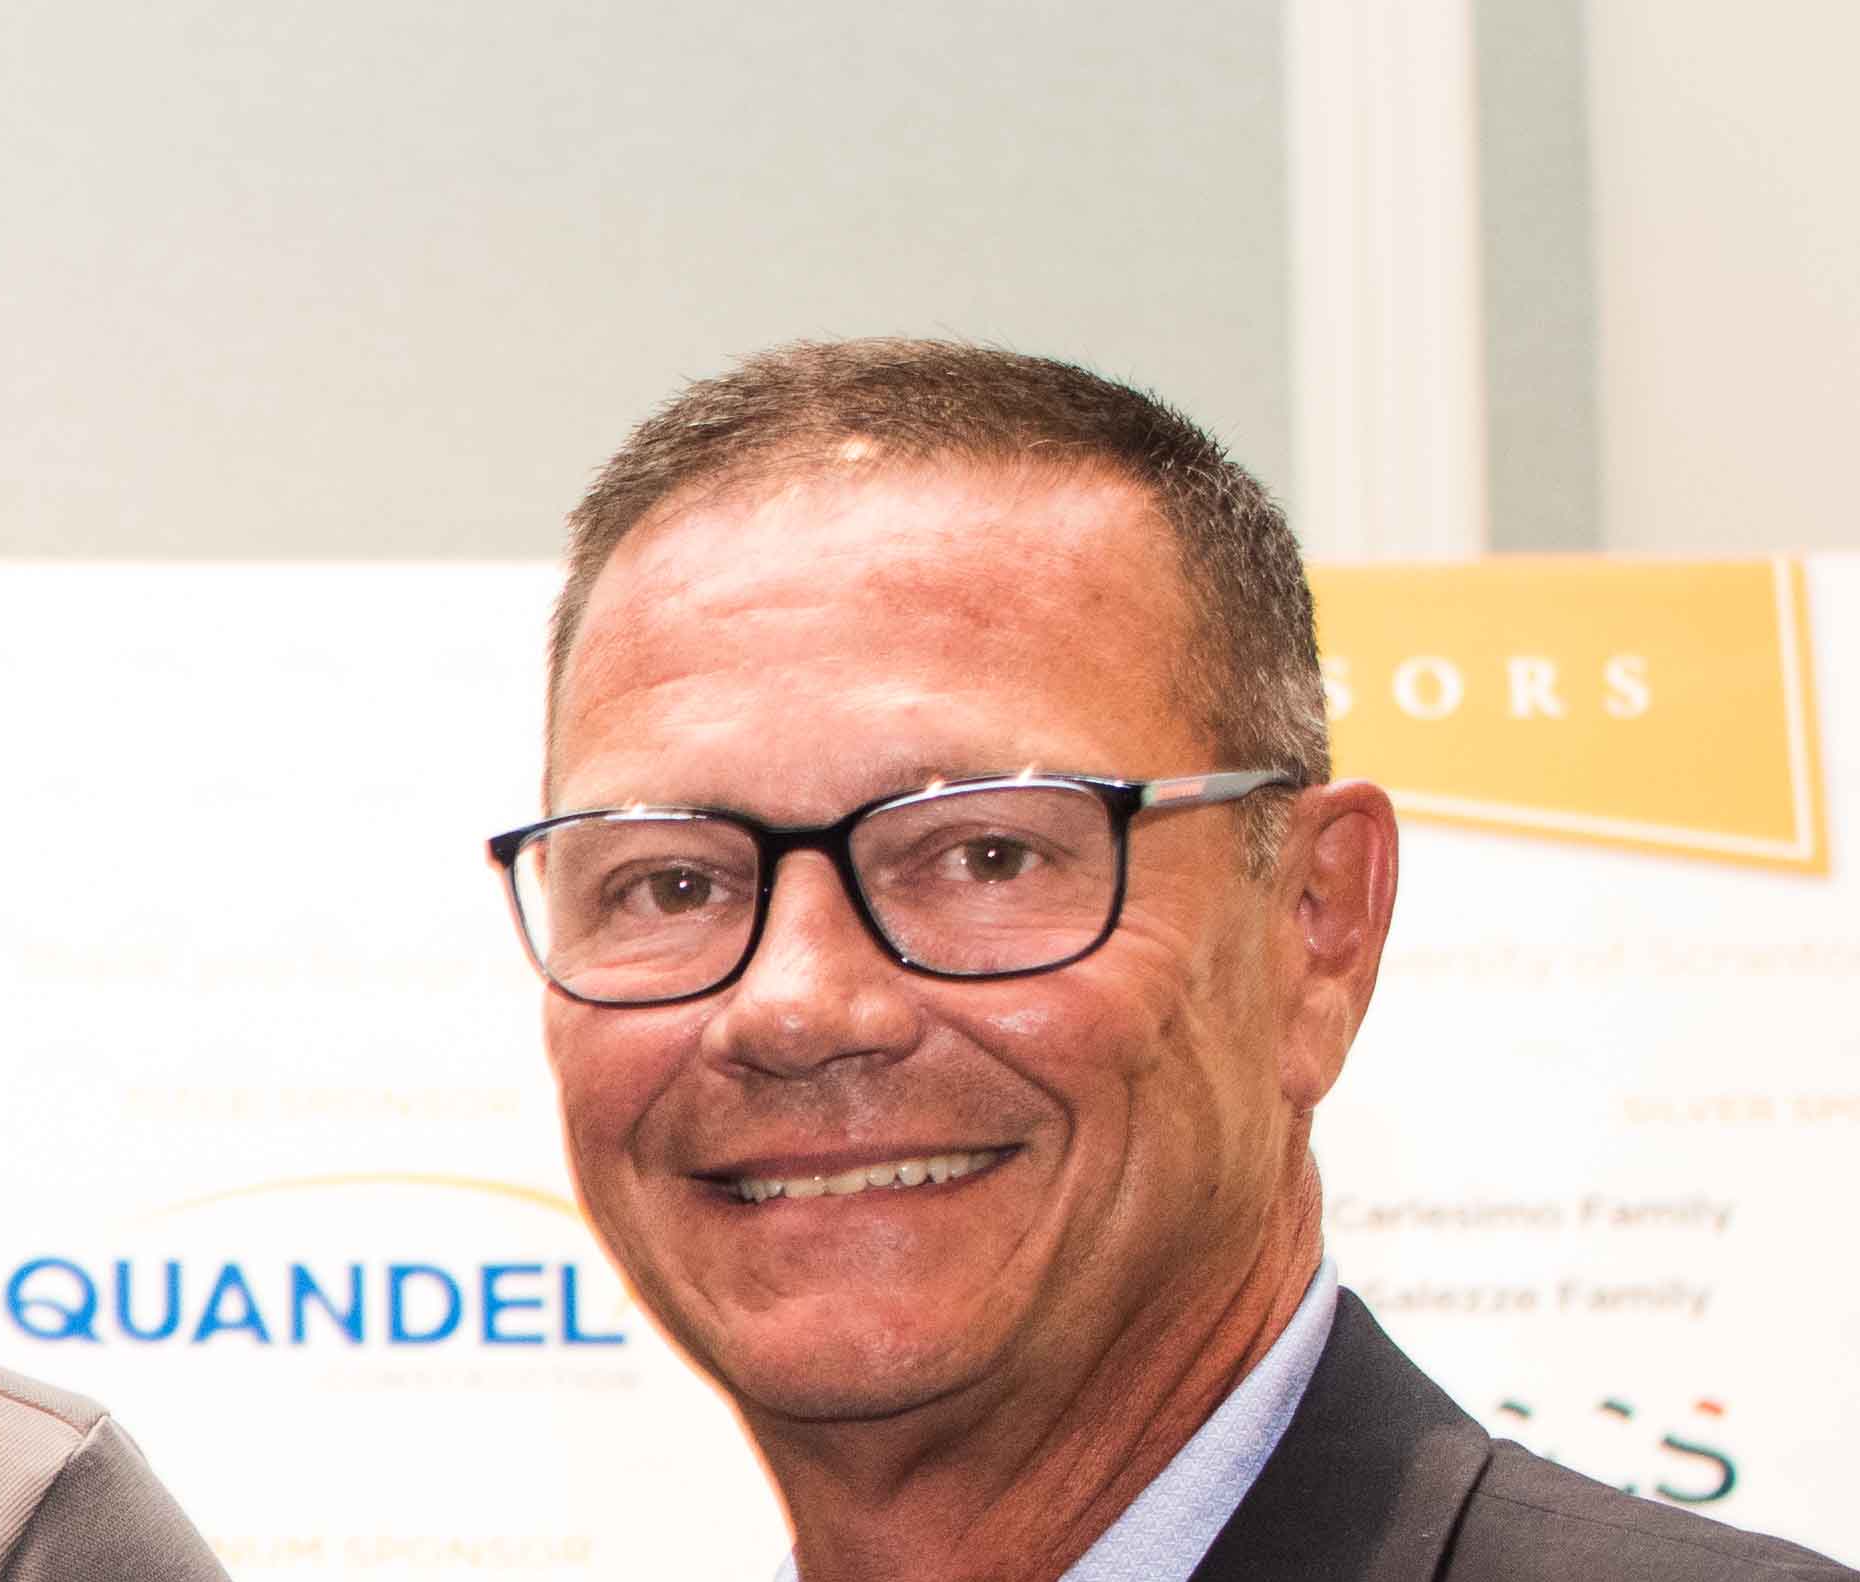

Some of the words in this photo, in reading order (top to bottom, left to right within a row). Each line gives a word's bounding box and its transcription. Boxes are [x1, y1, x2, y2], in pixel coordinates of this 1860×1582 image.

[1579, 1191, 1736, 1235] Family
[4, 1256, 626, 1347] QUANDEL
[1558, 1276, 1711, 1320] Family
